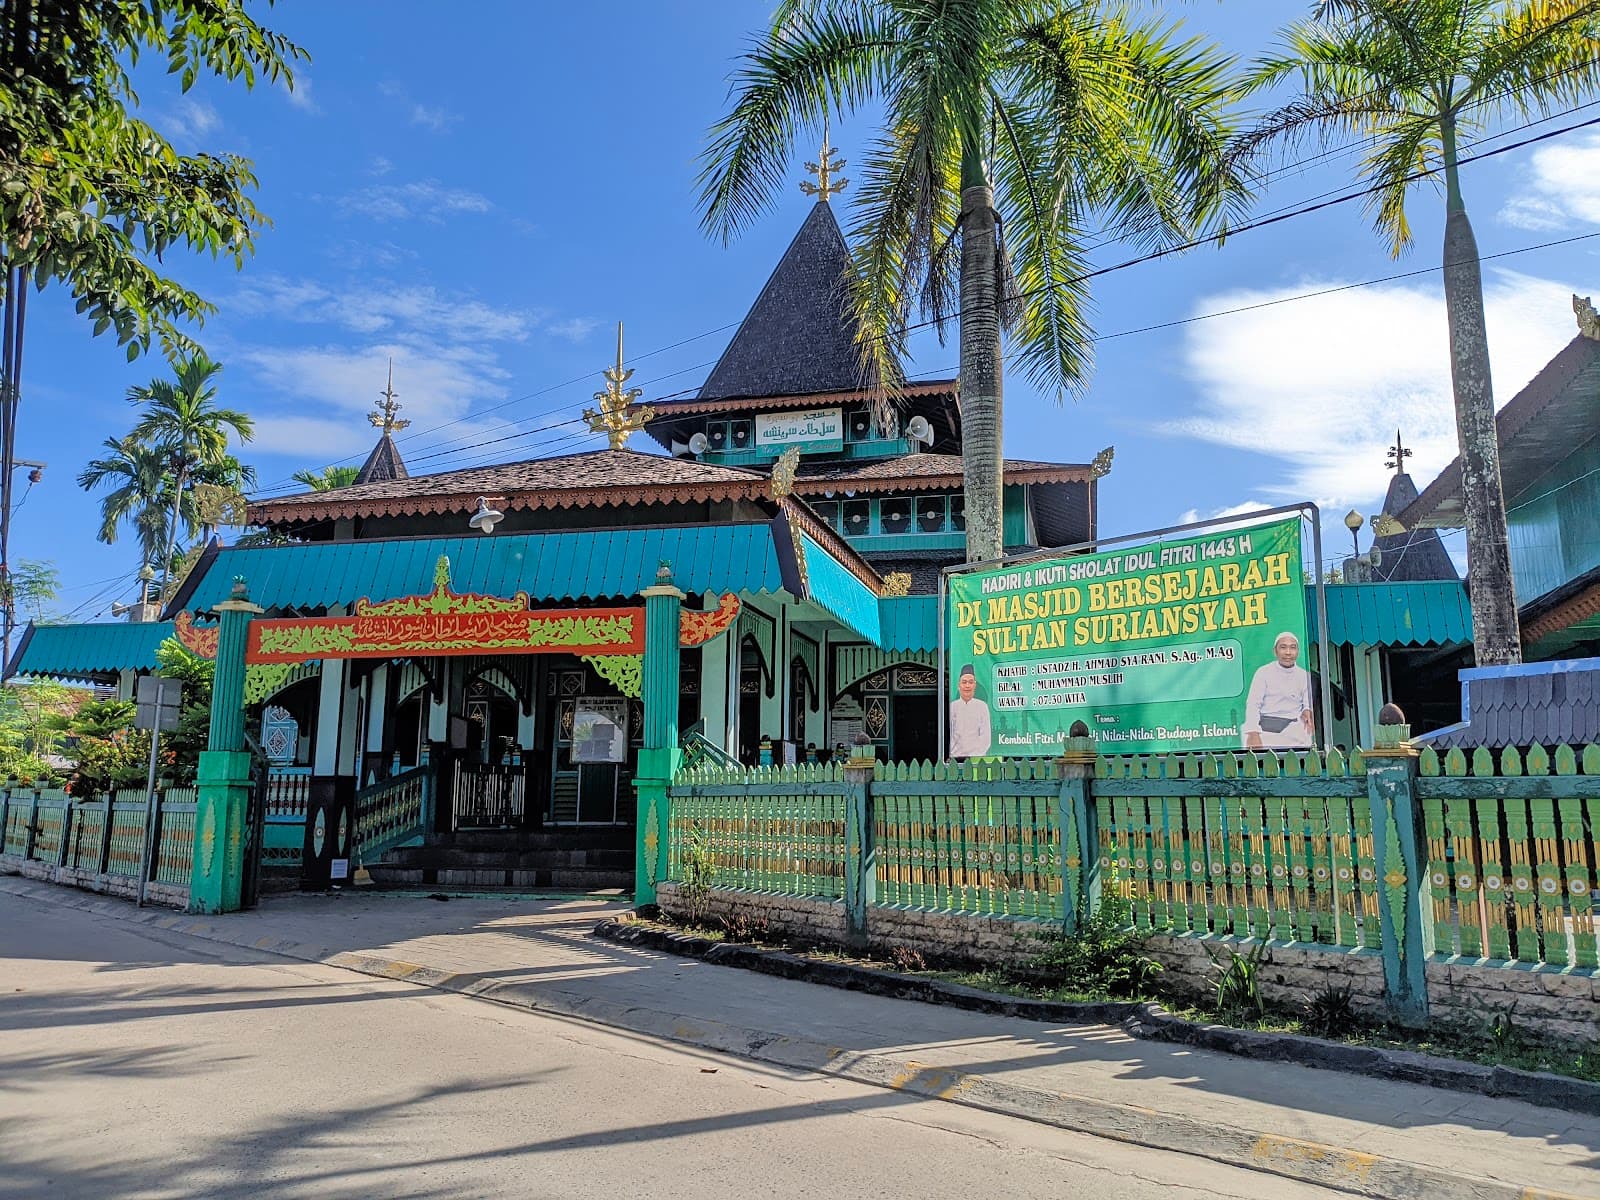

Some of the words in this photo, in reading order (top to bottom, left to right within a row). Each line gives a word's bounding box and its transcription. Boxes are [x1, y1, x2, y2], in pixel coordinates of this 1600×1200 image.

[981, 573, 1022, 594] HADIRI
[1024, 571, 1033, 588] &
[1035, 565, 1067, 586] IKUTI
[1069, 556, 1122, 581] SHOLAT
[1124, 551, 1157, 573] IDUL
[1160, 543, 1197, 567] FITRI
[1200, 537, 1236, 561] 1443
[1239, 534, 1253, 555] H
[957, 600, 983, 628] DI
[987, 587, 1082, 625] MASJID
[1087, 552, 1291, 612] BERSEJARAH
[972, 619, 1068, 656] SULTAN
[1074, 592, 1268, 646] SURIANSYAH
[997, 666, 1027, 678] KHATIB
[1037, 662, 1069, 674] USTADZ
[1072, 661, 1081, 671] H.
[1085, 658, 1118, 670] AHMAD
[1206, 646, 1234, 660] M.Ag
[998, 682, 1022, 692] BILAL
[1037, 676, 1087, 690] MUHAMMAD
[1089, 673, 1123, 685] MUSLIH
[998, 696, 1026, 707] WAKTU
[1038, 694, 1062, 706] 07.30
[1065, 692, 1086, 704] WITA
[998, 732, 1033, 745] Kembali
[1034, 732, 1054, 745] Fitri
[1102, 728, 1155, 743] Nilai-Nilai
[1156, 725, 1201, 741] Budaya
[1202, 723, 1239, 738] Islami
